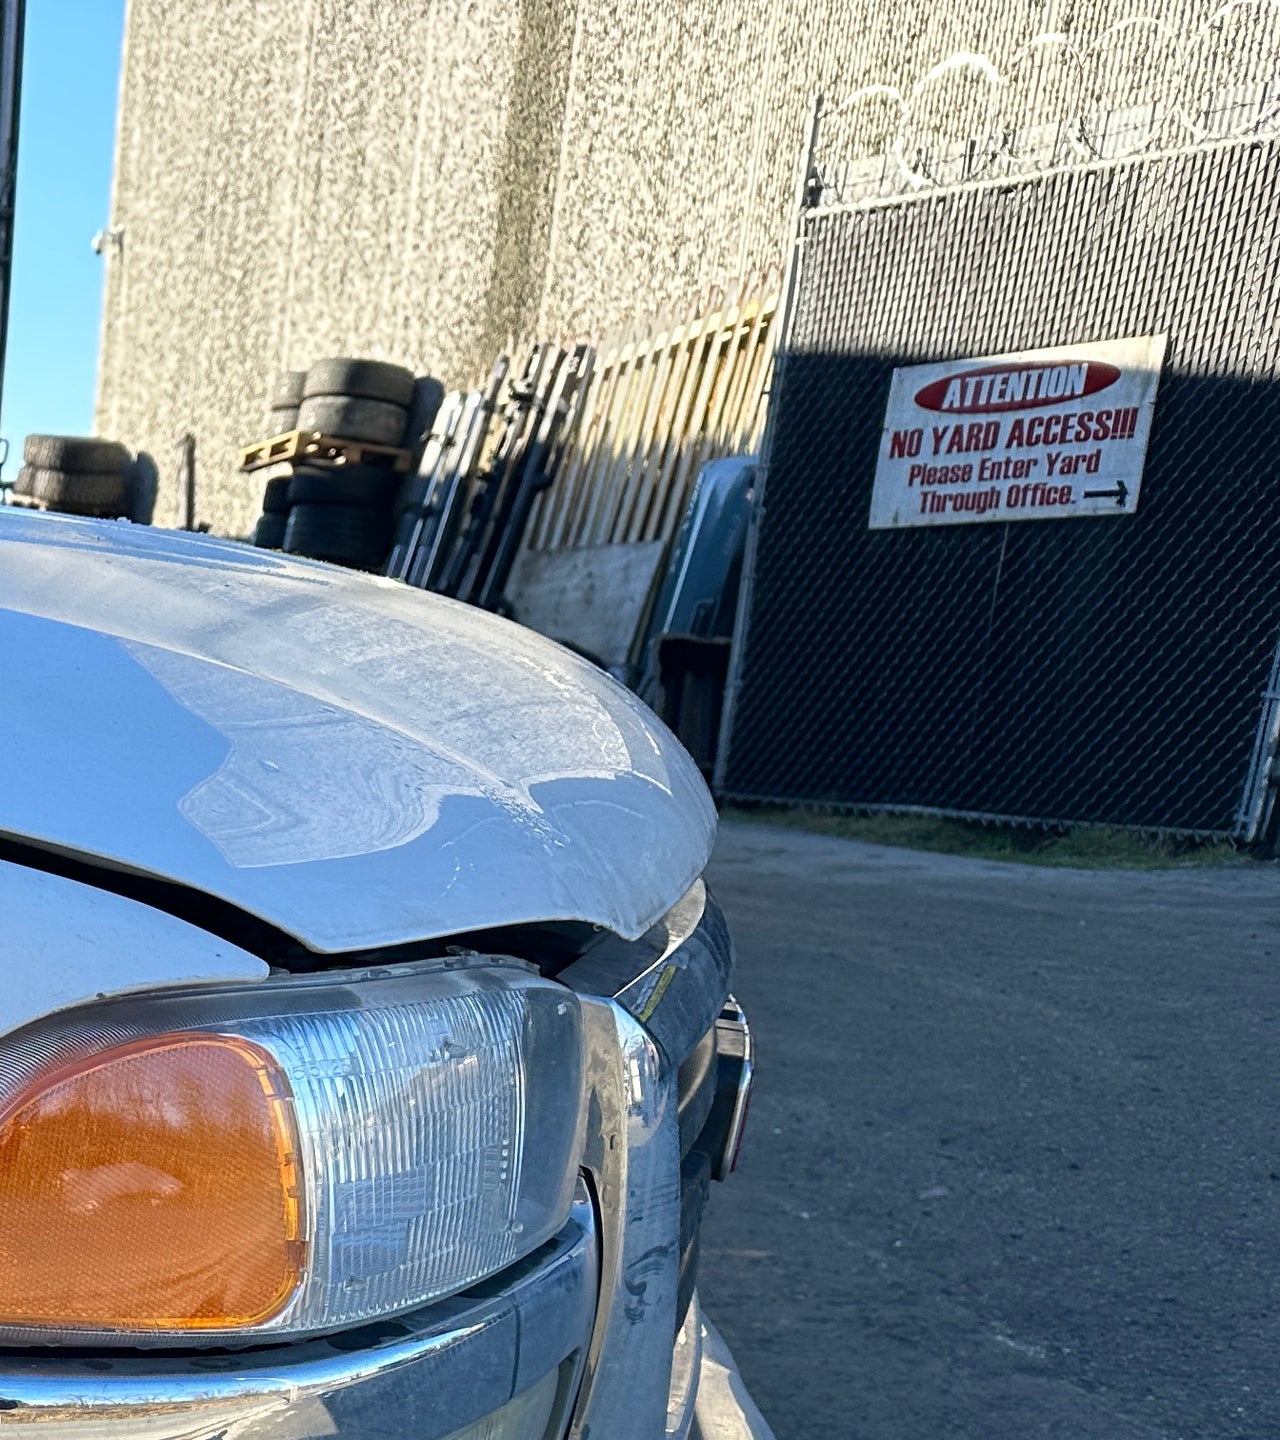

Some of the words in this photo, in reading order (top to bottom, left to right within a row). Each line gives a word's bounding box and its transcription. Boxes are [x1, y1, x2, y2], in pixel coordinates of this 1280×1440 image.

[942, 363, 1088, 409] ATTENTION
[889, 427, 924, 460] NO
[932, 420, 1000, 454] YARD
[1005, 407, 1138, 448] ACCESS!!!
[908, 462, 972, 487] Please
[978, 456, 1038, 481] Enter
[1045, 449, 1102, 476] Yard
[919, 484, 1000, 515] Through
